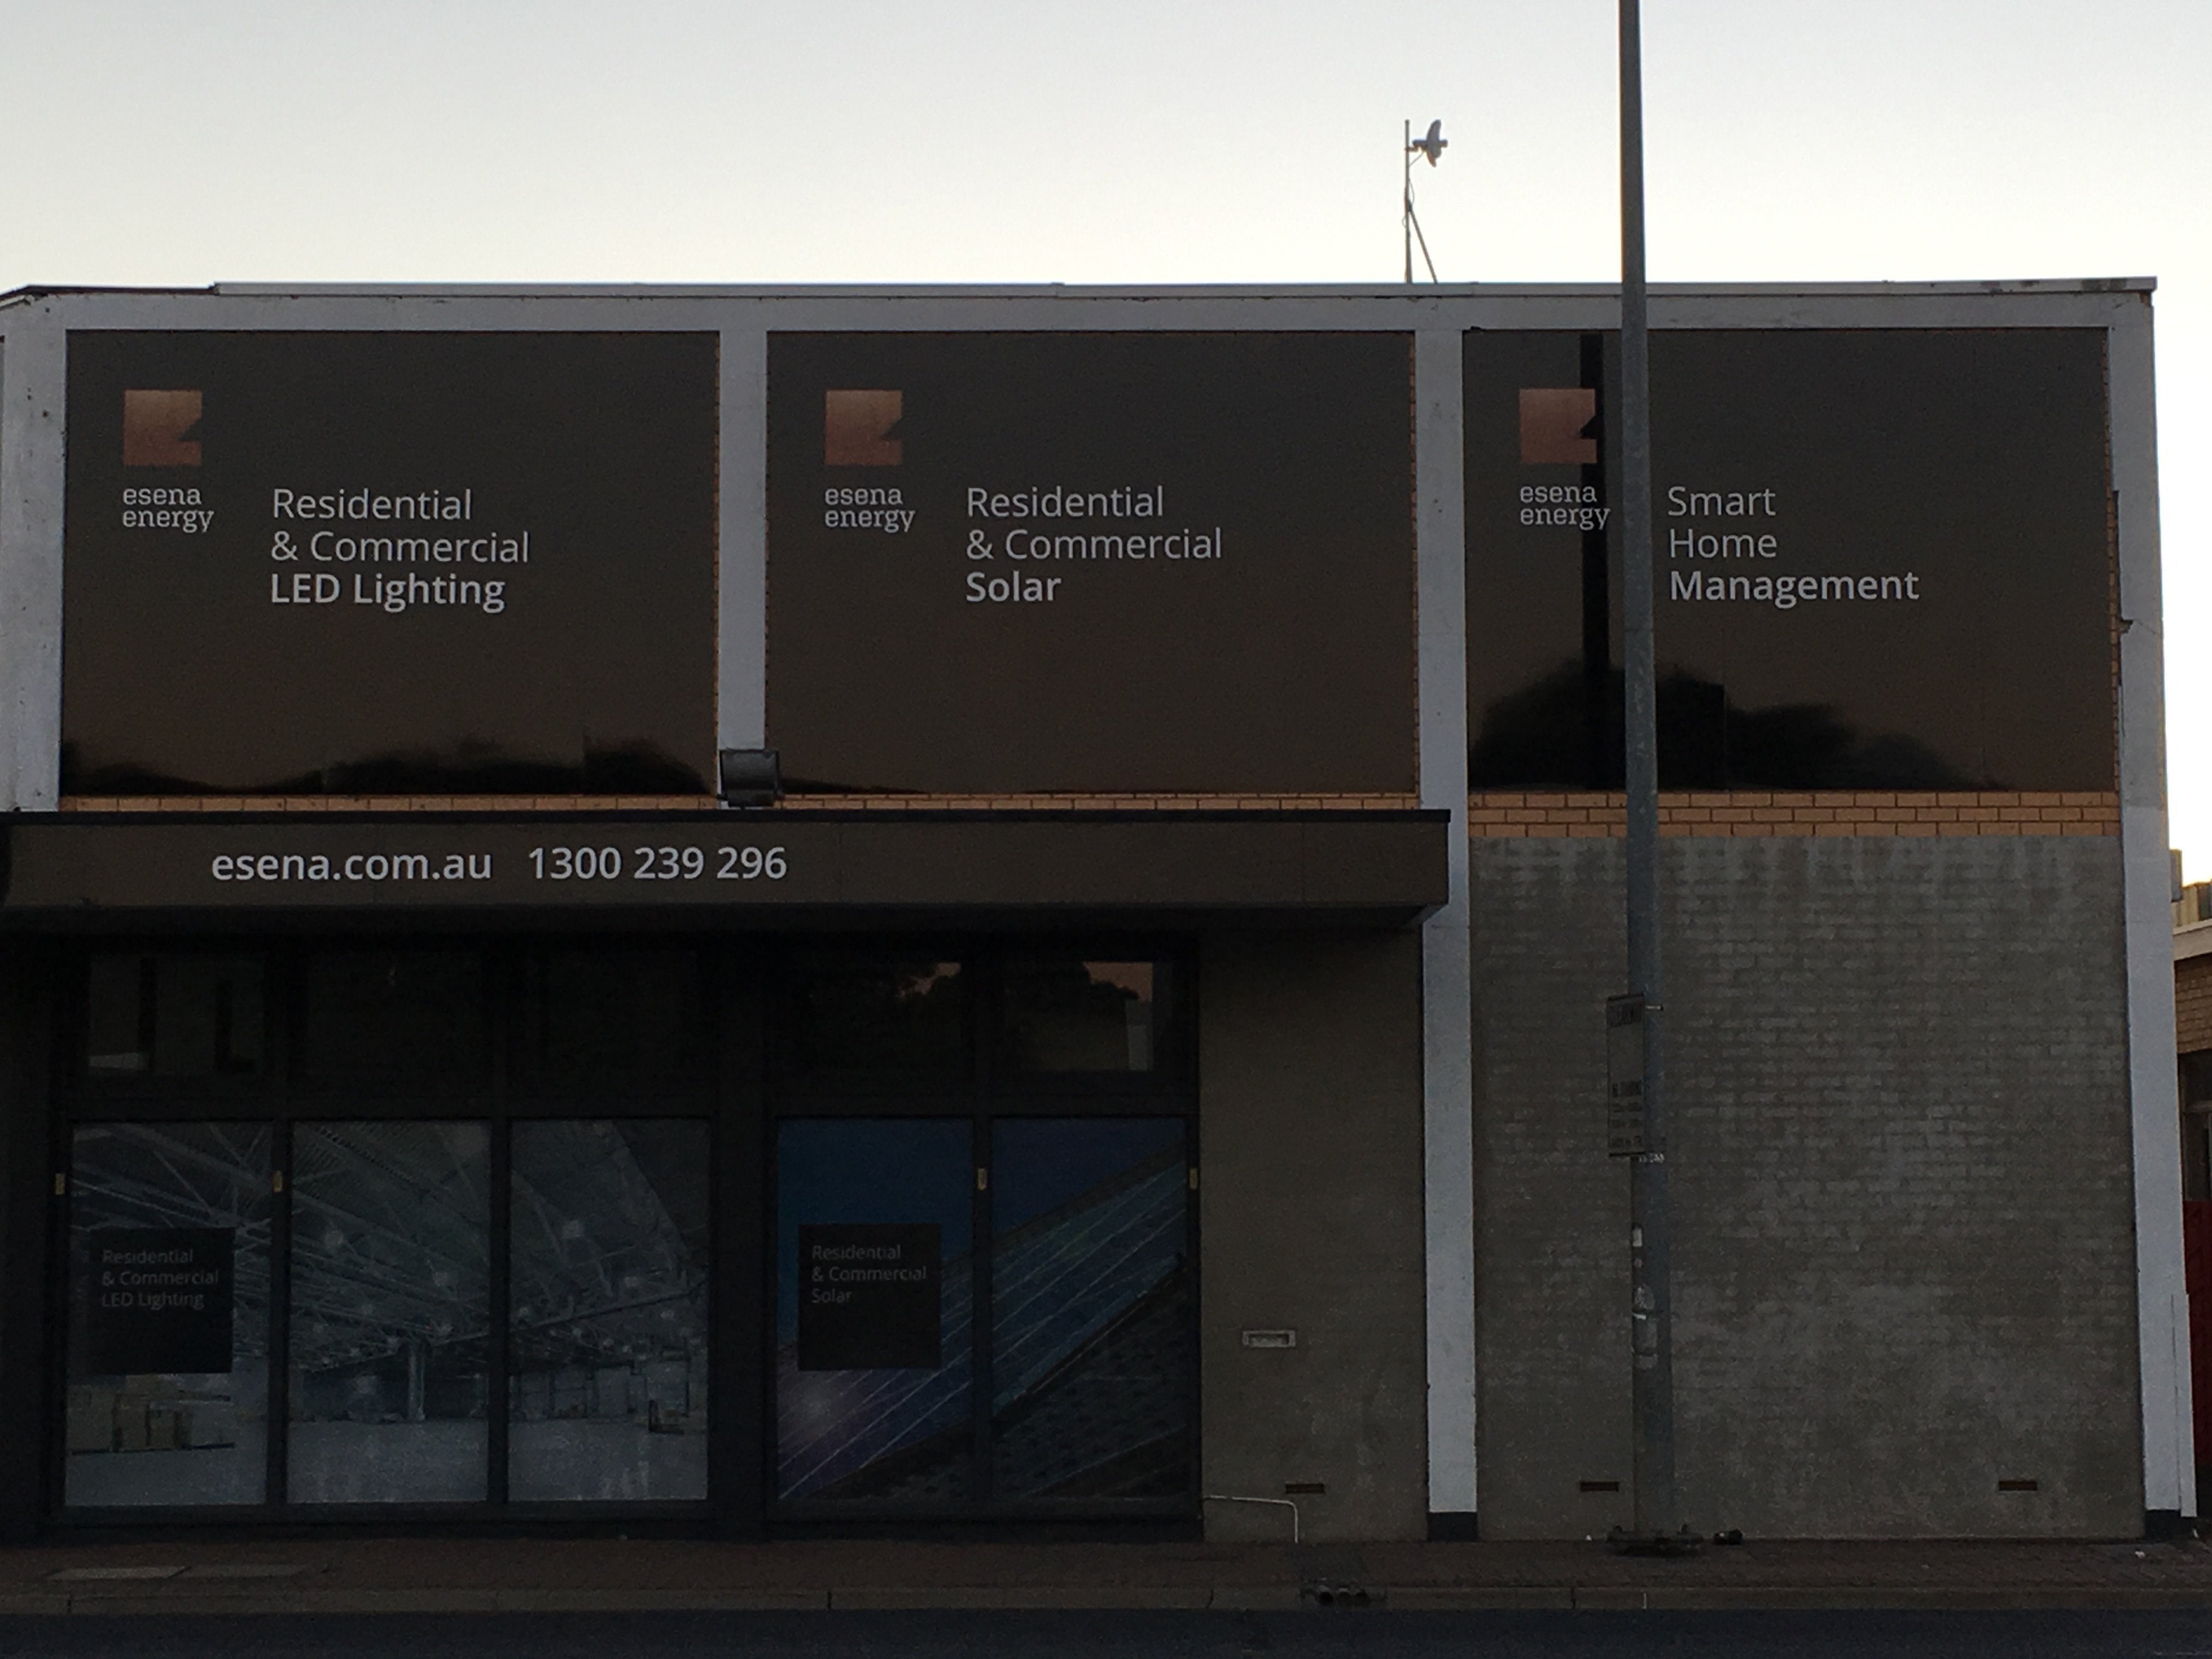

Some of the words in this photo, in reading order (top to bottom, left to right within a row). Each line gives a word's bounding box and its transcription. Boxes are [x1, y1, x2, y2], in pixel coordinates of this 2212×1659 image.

[122, 488, 202, 505] esena
[272, 487, 471, 521] Residential
[825, 488, 904, 505] esena
[967, 484, 1163, 518] Residential
[1519, 486, 1598, 503] esena
[1667, 486, 1776, 516] Smart
[122, 509, 215, 533] energy
[825, 509, 916, 533] energy
[1520, 507, 1611, 531] energy
[270, 530, 299, 561] &
[310, 530, 529, 562] Commercial
[966, 528, 994, 560] &
[1005, 526, 1221, 560] Commercial
[1669, 528, 1778, 558] Home
[271, 573, 340, 603] LED
[354, 572, 506, 614] Lighting
[966, 569, 1062, 602] Solar
[1671, 570, 1920, 610] Management
[211, 854, 491, 881] esena.com.au
[528, 847, 622, 879] 1300
[633, 846, 704, 880] 239
[716, 846, 787, 879] 296
[102, 1249, 194, 1264] Residential
[811, 1244, 901, 1260] Residential
[102, 1271, 115, 1286] &
[119, 1269, 219, 1286] Commercial
[811, 1266, 824, 1282] &
[828, 1265, 927, 1282] Commercial
[101, 1292, 134, 1308] LED
[138, 1291, 205, 1311] Lighting
[810, 1288, 853, 1304] Solar
